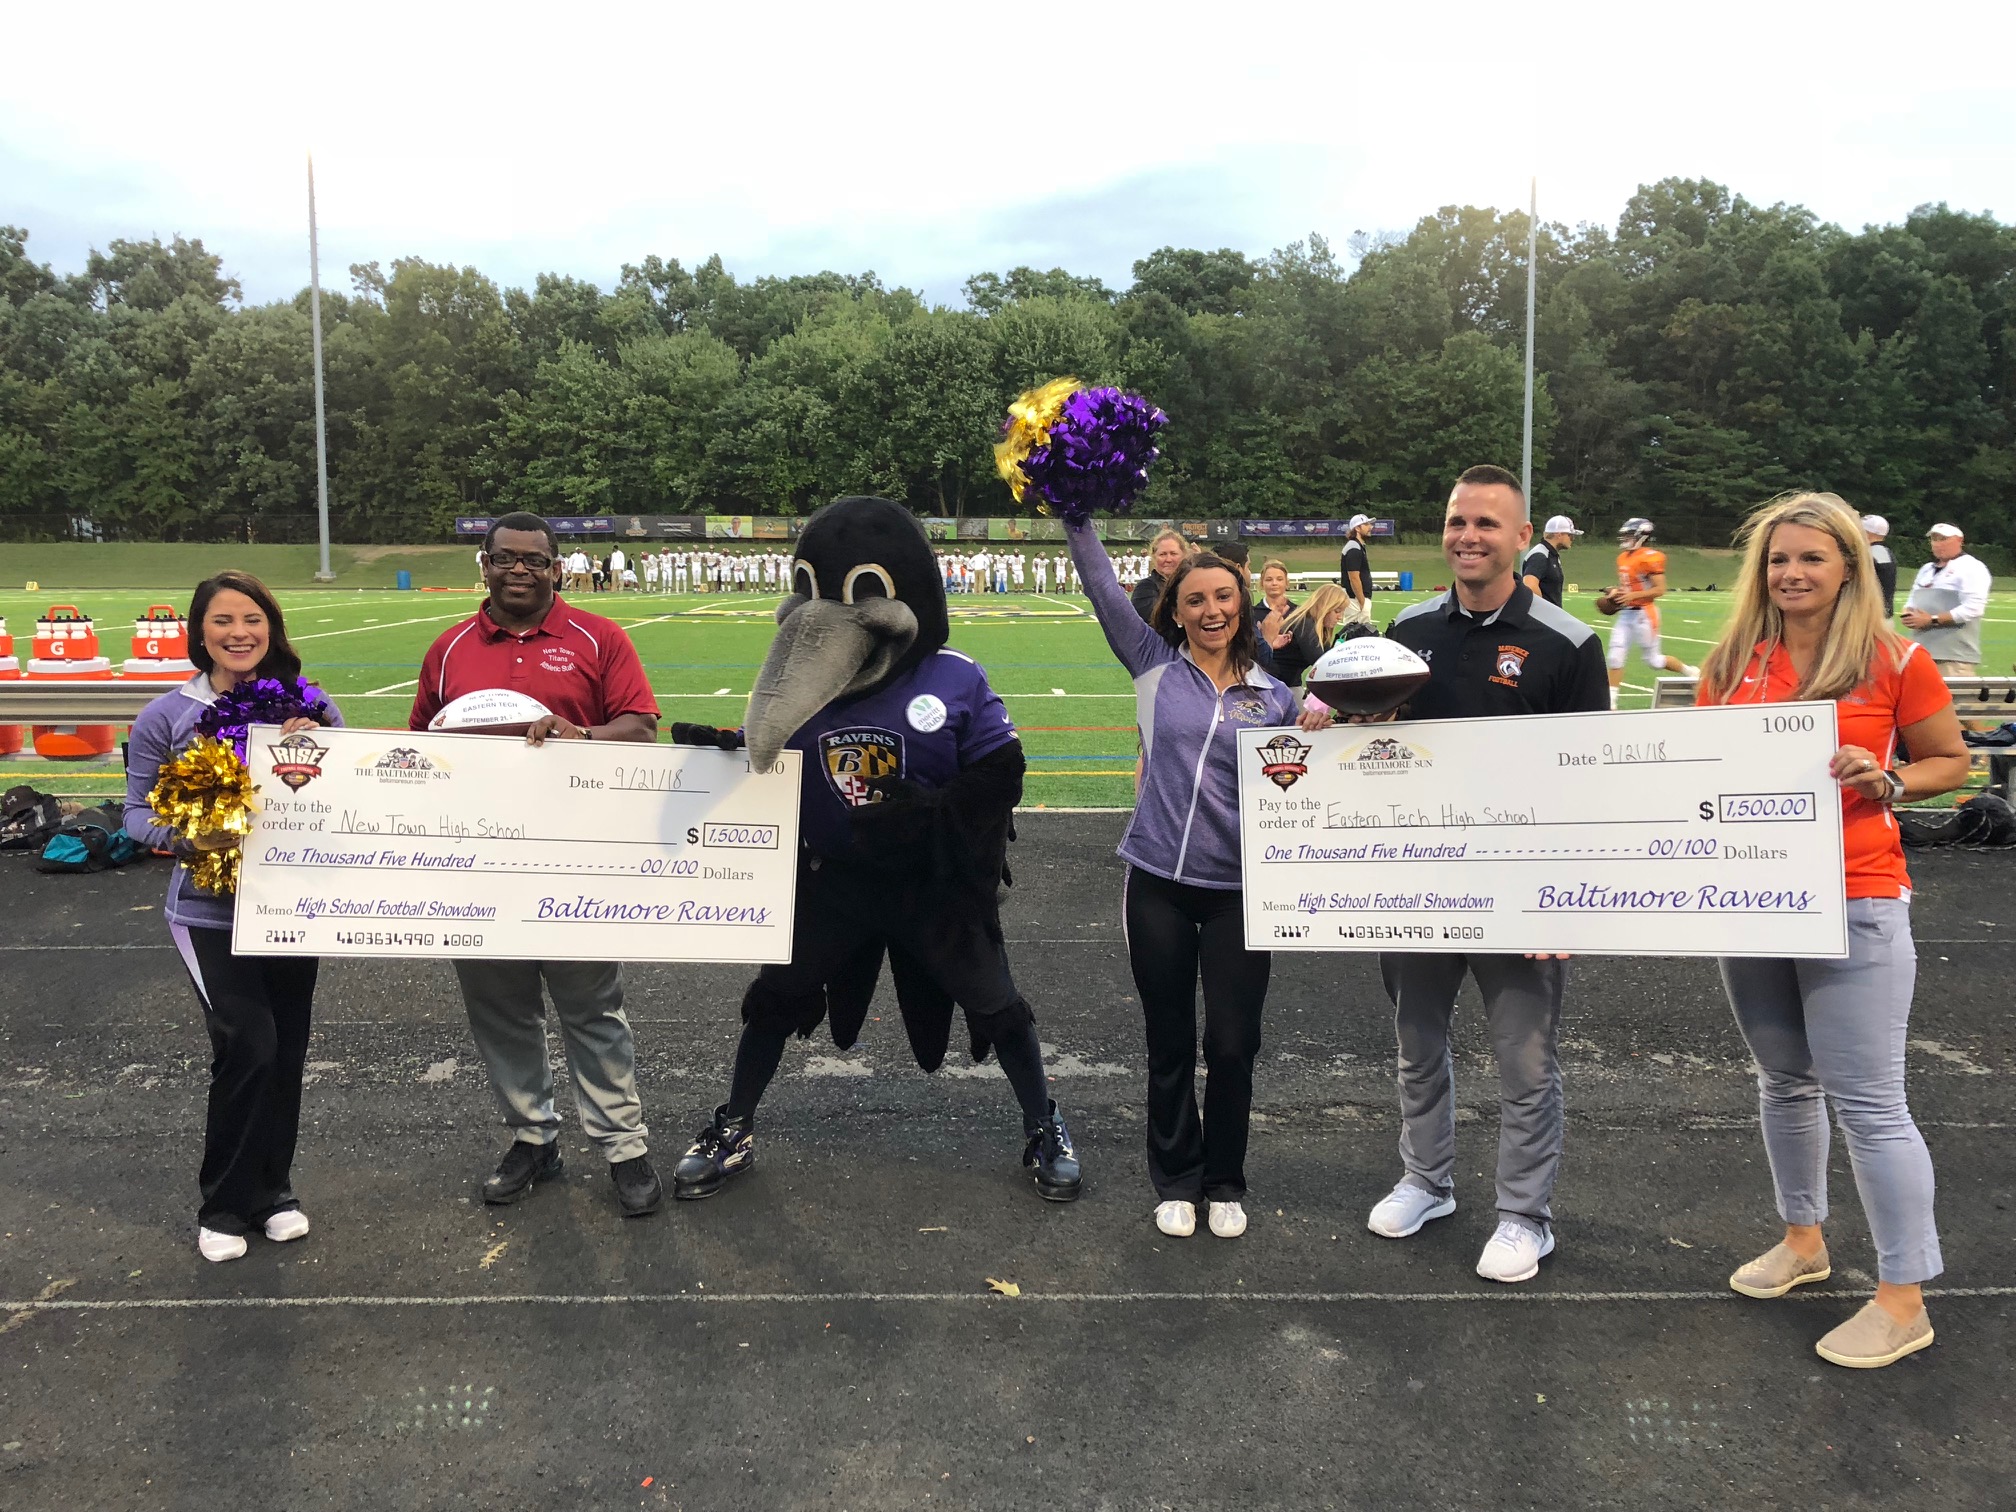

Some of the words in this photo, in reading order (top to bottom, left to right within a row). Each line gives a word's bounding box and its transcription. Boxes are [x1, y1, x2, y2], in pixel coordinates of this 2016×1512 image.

[50, 641, 65, 655] G
[146, 640, 159, 654] G
[558, 647, 575, 657] Town
[1327, 656, 1359, 667] EASTERN
[1488, 675, 1519, 688] FOOTBALL
[462, 702, 497, 713] EASTERN
[498, 701, 518, 709] TECH
[462, 716, 499, 724] SEPTEMBER
[918, 707, 940, 725] merritt
[923, 713, 945, 731] clubs
[1762, 714, 1815, 733] 1000
[827, 733, 896, 747] RAVENS
[269, 746, 327, 765] RISE
[1258, 746, 1311, 764] RISE
[1602, 740, 1666, 763] 9/21/18
[1338, 762, 1357, 771] THE
[1359, 760, 1411, 770] BALTIMORE
[1414, 759, 1433, 769] SUN
[1557, 752, 1598, 767] Date
[354, 768, 373, 777] THE
[376, 768, 430, 779] BALTIMORE
[432, 771, 451, 780] SUN
[379, 777, 426, 785] baltimoresun.com
[614, 766, 684, 791] 9/21/18
[569, 775, 604, 789] Date
[264, 798, 290, 814] Pay
[293, 800, 307, 813] to
[310, 800, 332, 813] the
[1259, 798, 1282, 813] Pay
[1285, 799, 1298, 811] to
[1301, 797, 1321, 810] the
[1699, 801, 1714, 822] $
[1726, 797, 1807, 818] 1,500.00
[1259, 816, 1298, 829] order
[1302, 815, 1316, 829] of
[1327, 801, 1381, 828] Eastern
[1387, 804, 1430, 828] Tech
[1441, 803, 1475, 831] High
[1484, 806, 1536, 828] School
[262, 819, 305, 831] order
[309, 819, 325, 832] of
[340, 809, 380, 833] New
[385, 813, 426, 836] Town
[439, 815, 469, 843] High
[477, 818, 526, 840] School
[686, 827, 699, 846] $
[708, 827, 773, 844] 1,500.00
[264, 846, 296, 863] One
[301, 848, 376, 866] Thousand
[379, 850, 407, 866] Five
[410, 852, 476, 868] Hundred
[1265, 845, 1292, 860] One
[1298, 844, 1367, 860] Thousand
[1371, 843, 1397, 859] Five
[1402, 842, 1467, 859] Hundred
[1723, 845, 1788, 860] Dollars
[702, 867, 754, 881] Dollars
[1298, 893, 1326, 914] High
[1329, 893, 1371, 909] School
[1373, 893, 1421, 909] Football
[1424, 892, 1494, 909] Showdown
[1537, 882, 1693, 909] Baltimore
[1697, 884, 1816, 911] Ravens
[256, 904, 293, 916] Memo
[295, 897, 326, 919] High
[330, 898, 373, 915] School
[376, 899, 425, 917] Football
[427, 900, 497, 918] Showdown
[537, 895, 674, 920] Baltimore
[677, 899, 772, 924] Ravens
[1262, 901, 1296, 912] Memo
[265, 930, 306, 943] 21117
[336, 931, 434, 946] 4103634990
[443, 933, 483, 947] 1000
[1273, 925, 1310, 938] 21117
[1338, 926, 1433, 939] 4103634990
[1443, 926, 1484, 939] 1000
